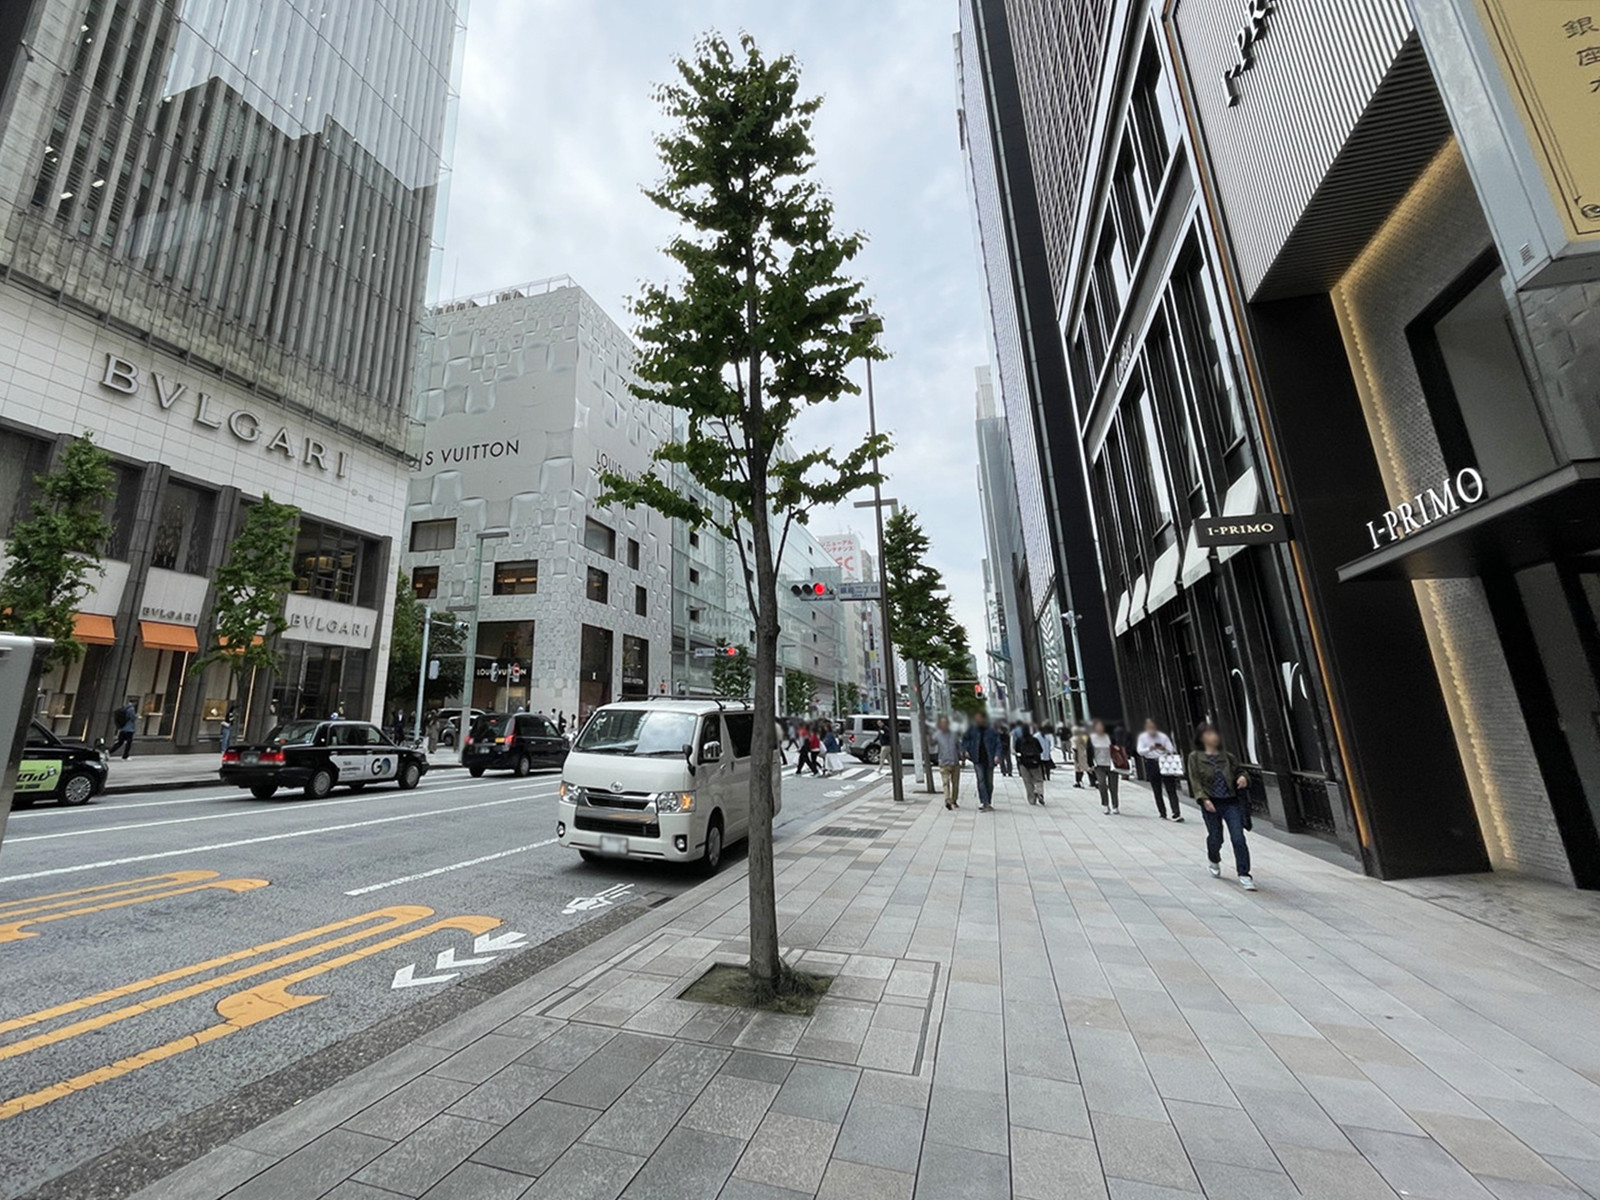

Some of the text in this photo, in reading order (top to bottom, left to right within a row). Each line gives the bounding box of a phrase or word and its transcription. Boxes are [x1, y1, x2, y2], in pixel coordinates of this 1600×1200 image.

[100, 353, 348, 478] BVLGARI
[441, 440, 519, 463] VUITTON
[1366, 467, 1483, 549] I-PRIMO
[1208, 523, 1274, 536] I-PRIMO
[142, 606, 198, 622] BVLGARI
[290, 613, 369, 638] BVLGARI
